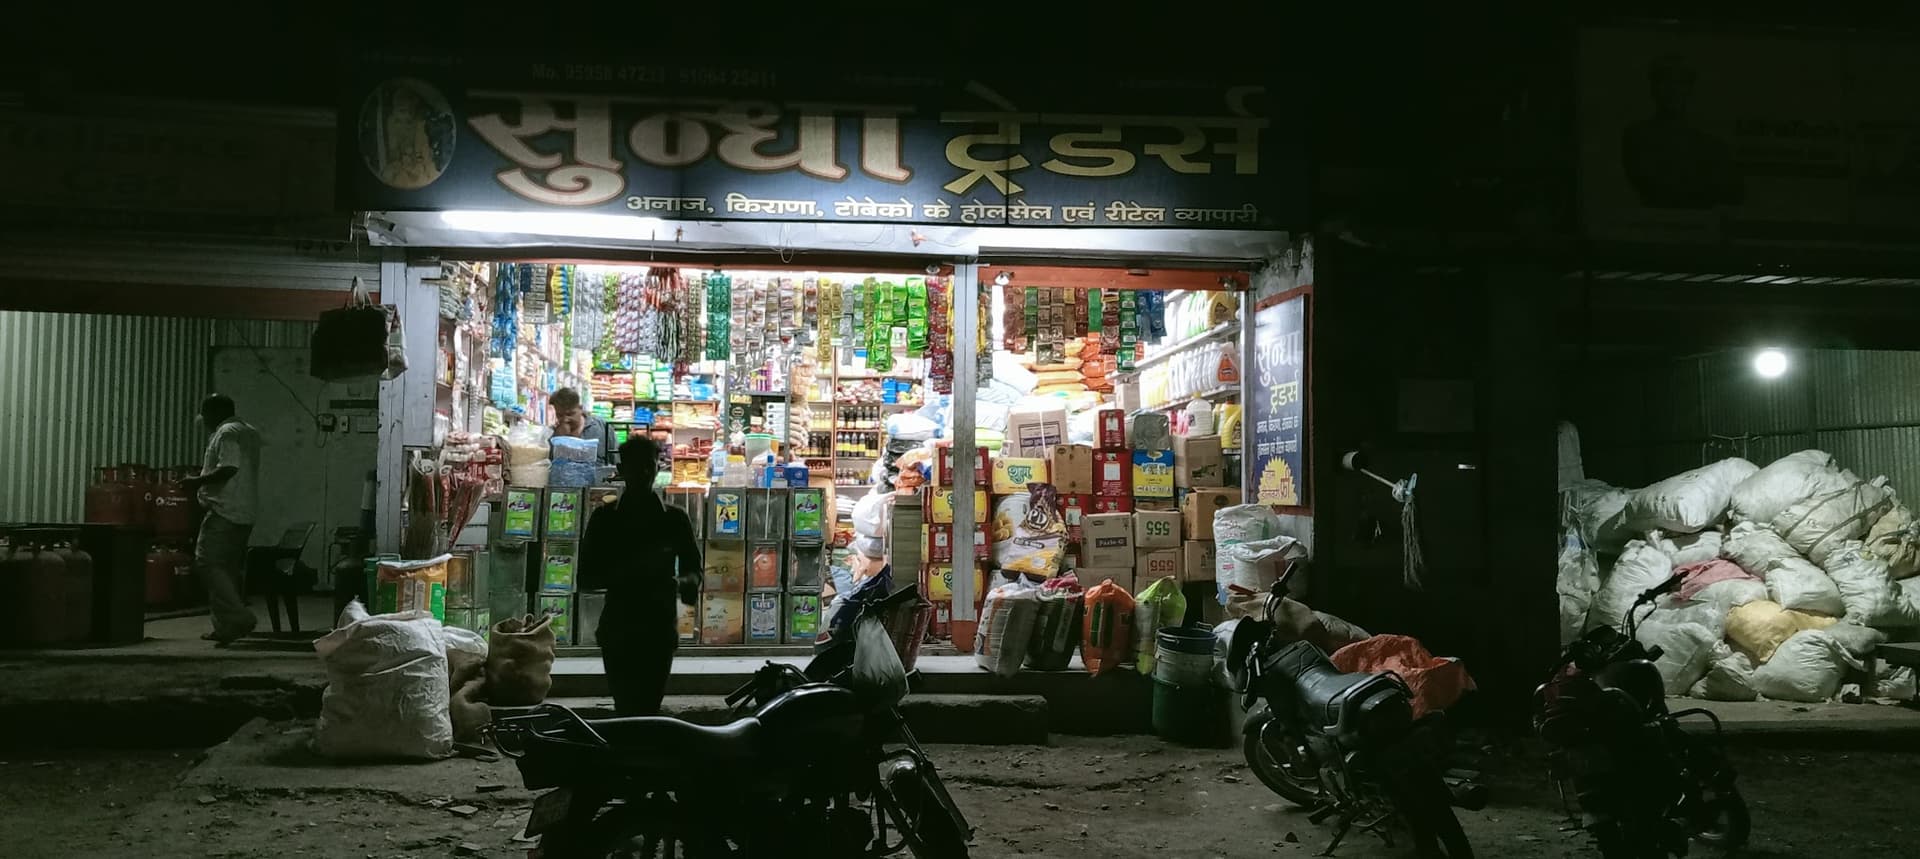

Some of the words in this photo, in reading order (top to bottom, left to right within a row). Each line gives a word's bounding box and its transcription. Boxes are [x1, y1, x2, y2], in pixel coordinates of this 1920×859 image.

[466, 89, 914, 206] सुन्धा
[940, 80, 1271, 196] ट्रेडर्स
[627, 195, 715, 214] अनाज,
[725, 193, 825, 217] किराणा,
[834, 196, 914, 218] टोबेको
[922, 198, 952, 219] के
[960, 199, 1053, 224] होलसेल
[1062, 202, 1095, 222] एवं
[1104, 202, 1166, 222] रीटेल
[1174, 204, 1259, 223] व्यापारी
[1269, 370, 1299, 414] ट्रेडर्स
